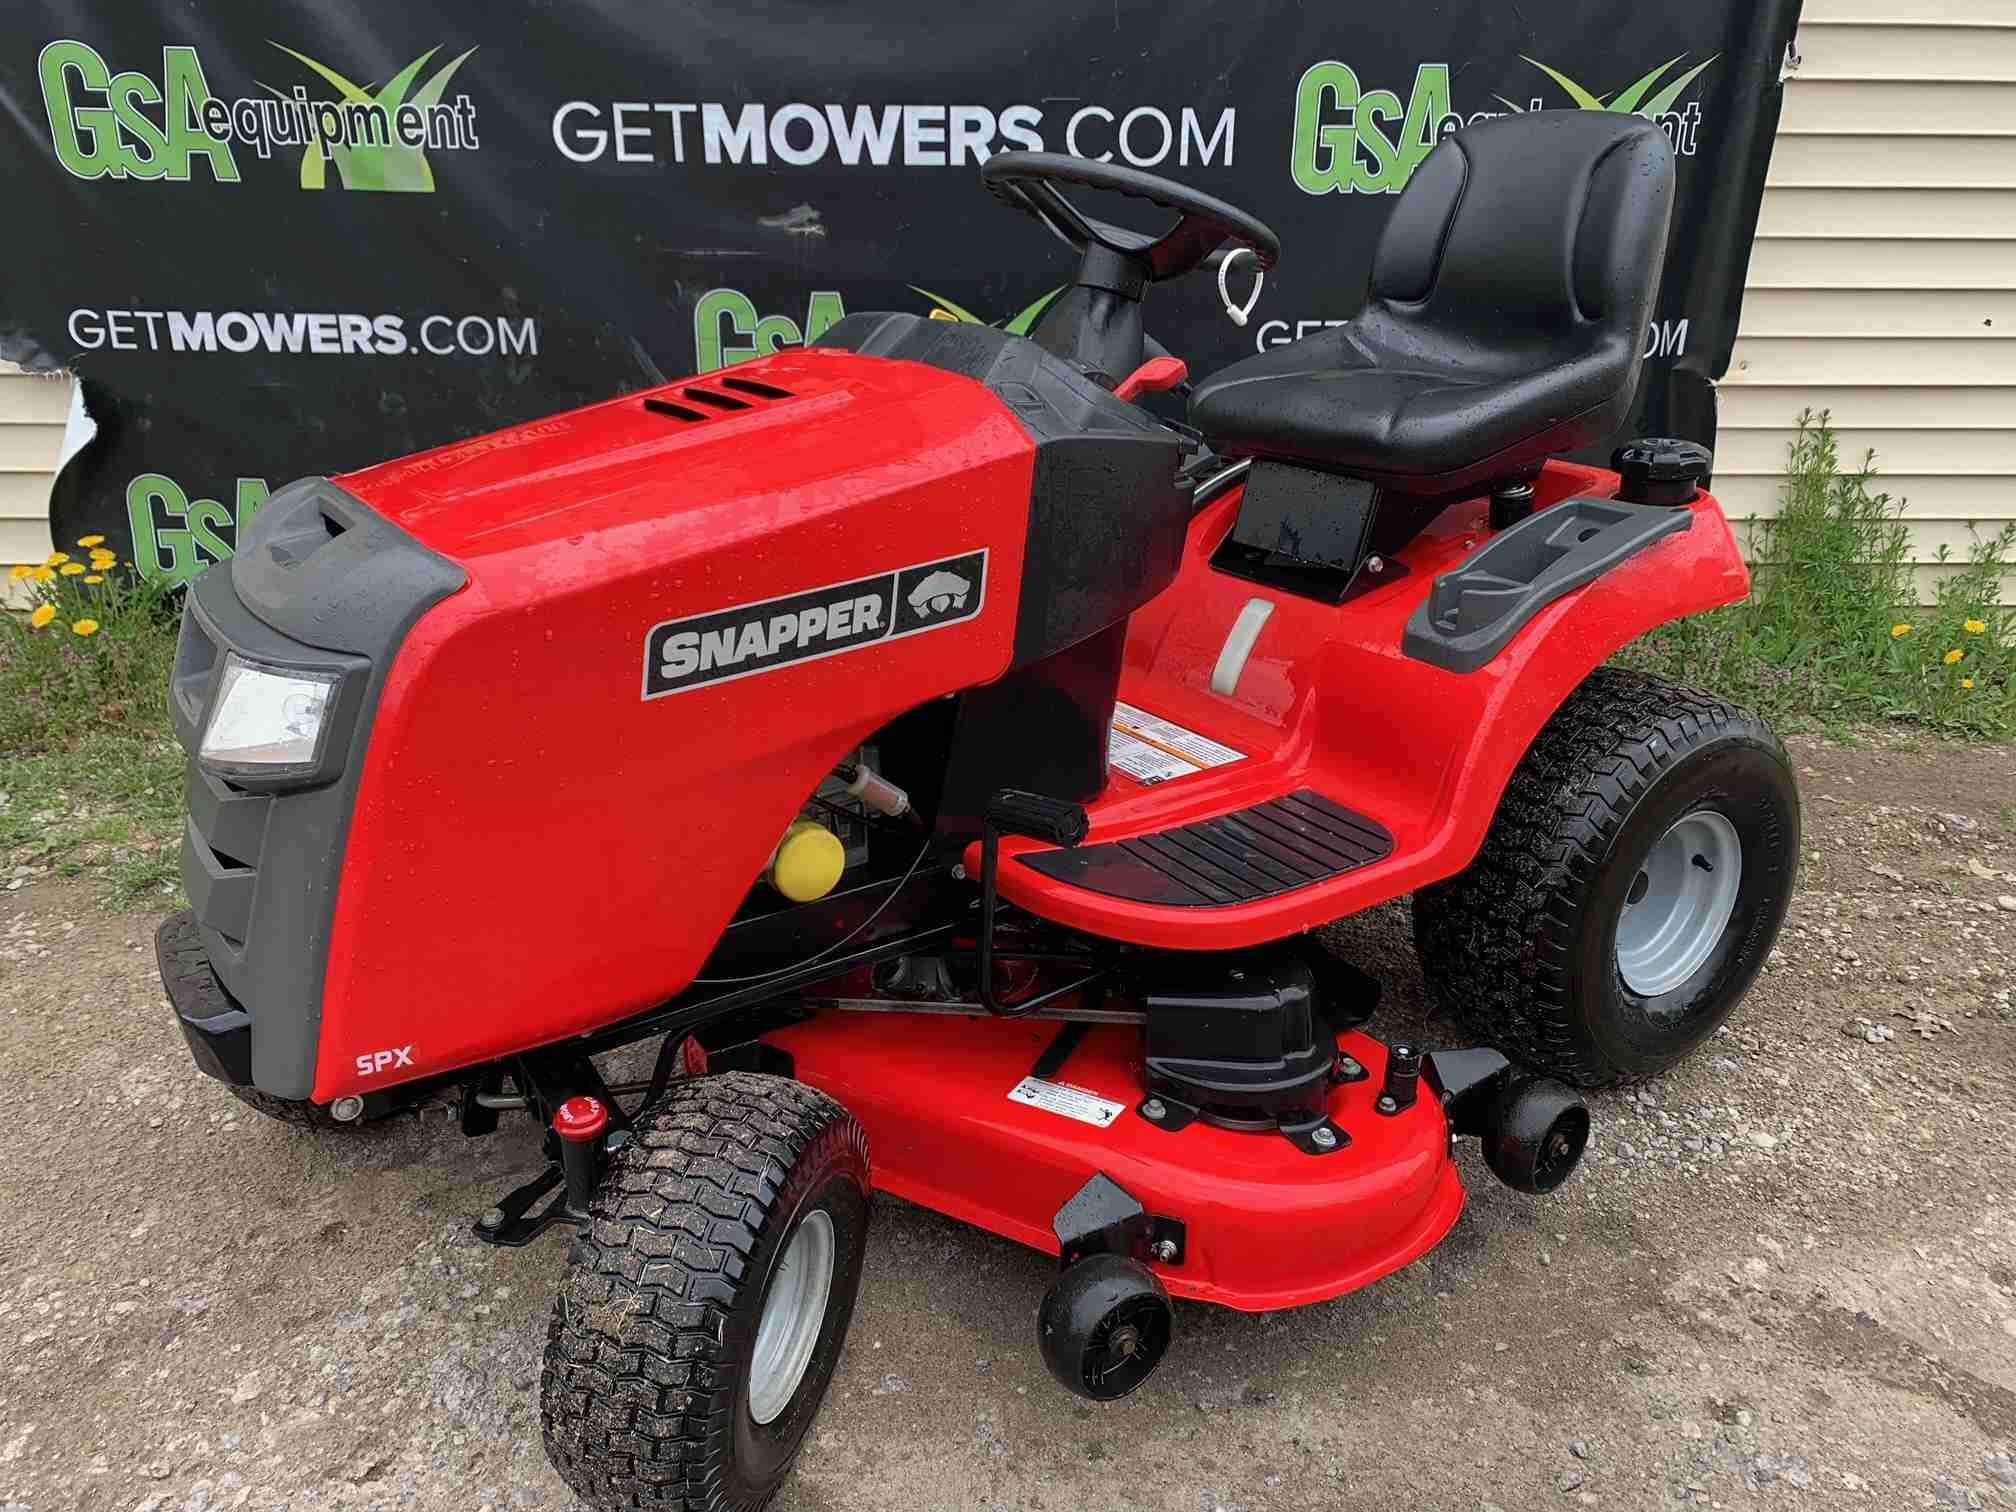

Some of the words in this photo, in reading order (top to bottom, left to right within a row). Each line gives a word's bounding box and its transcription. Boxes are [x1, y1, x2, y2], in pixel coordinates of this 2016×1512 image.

[199, 86, 480, 160] equipment
[66, 307, 539, 357] GETMOWERS.COM
[660, 593, 884, 679] SNAPPER
[355, 1045, 415, 1077] SPX
